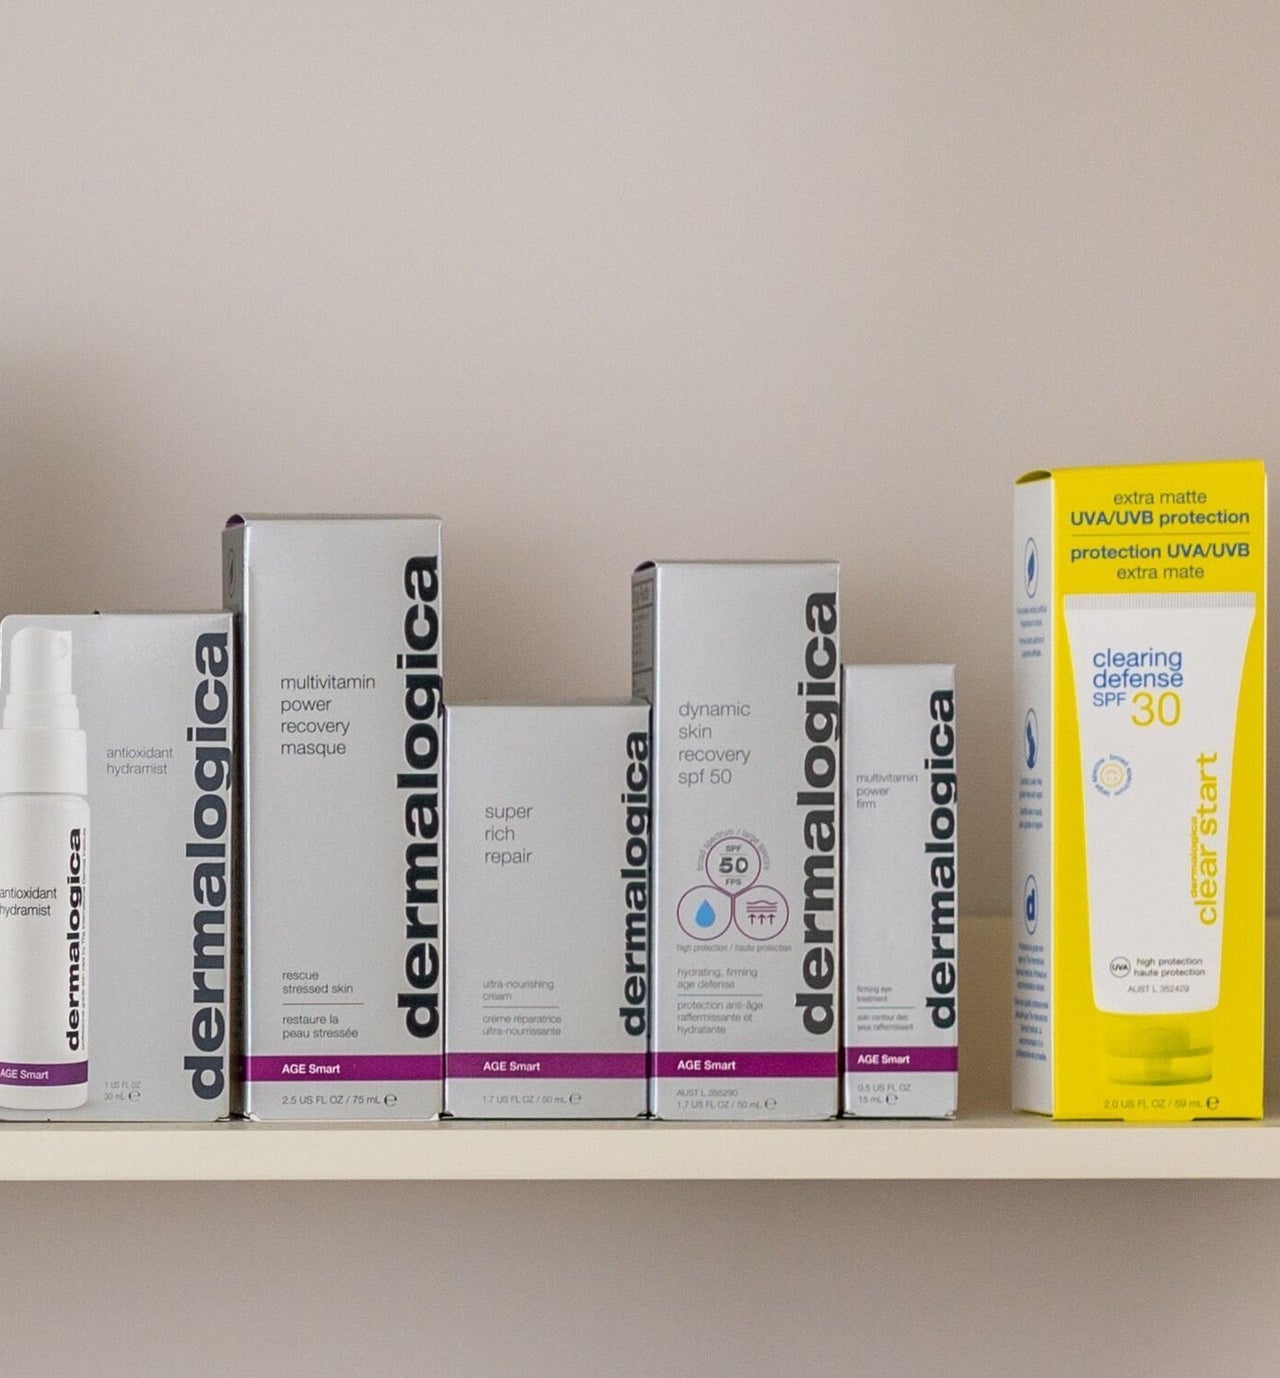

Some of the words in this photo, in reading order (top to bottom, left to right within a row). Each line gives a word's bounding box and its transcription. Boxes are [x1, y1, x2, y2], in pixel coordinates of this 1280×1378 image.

[1114, 492, 1155, 504] extra
[1160, 491, 1206, 504] matte
[1071, 511, 1153, 526] UVA/UVB
[1159, 510, 1249, 527] protection
[1093, 649, 1182, 670] clearing
[281, 675, 375, 689] multivitamin
[1093, 669, 1183, 688] defense
[281, 698, 332, 715] power
[678, 702, 751, 719] dynamic
[1093, 693, 1126, 707] SPF
[1131, 691, 1181, 727] 30
[281, 720, 350, 736] recovery
[678, 723, 712, 739] skin
[281, 742, 346, 757] masque
[678, 747, 751, 765] recovery
[678, 769, 705, 786] spf
[710, 769, 732, 784] 50
[856, 773, 918, 782] multivitamin
[396, 555, 443, 1039] dermalogica
[856, 787, 889, 797] power
[1196, 753, 1216, 836] start
[856, 799, 876, 809] firm
[485, 806, 532, 821] super
[795, 592, 839, 1036] dermalogica
[485, 827, 515, 840] rich
[485, 849, 532, 865] repair
[718, 857, 748, 873] 50
[925, 689, 956, 1029] dermalogica
[184, 632, 231, 1100] dermalogica
[619, 731, 650, 1037] dermalogica
[1194, 843, 1216, 925] clear
[66, 828, 82, 1051] dermalogica
[282, 1065, 305, 1073] AGE
[309, 1064, 340, 1074] Smart
